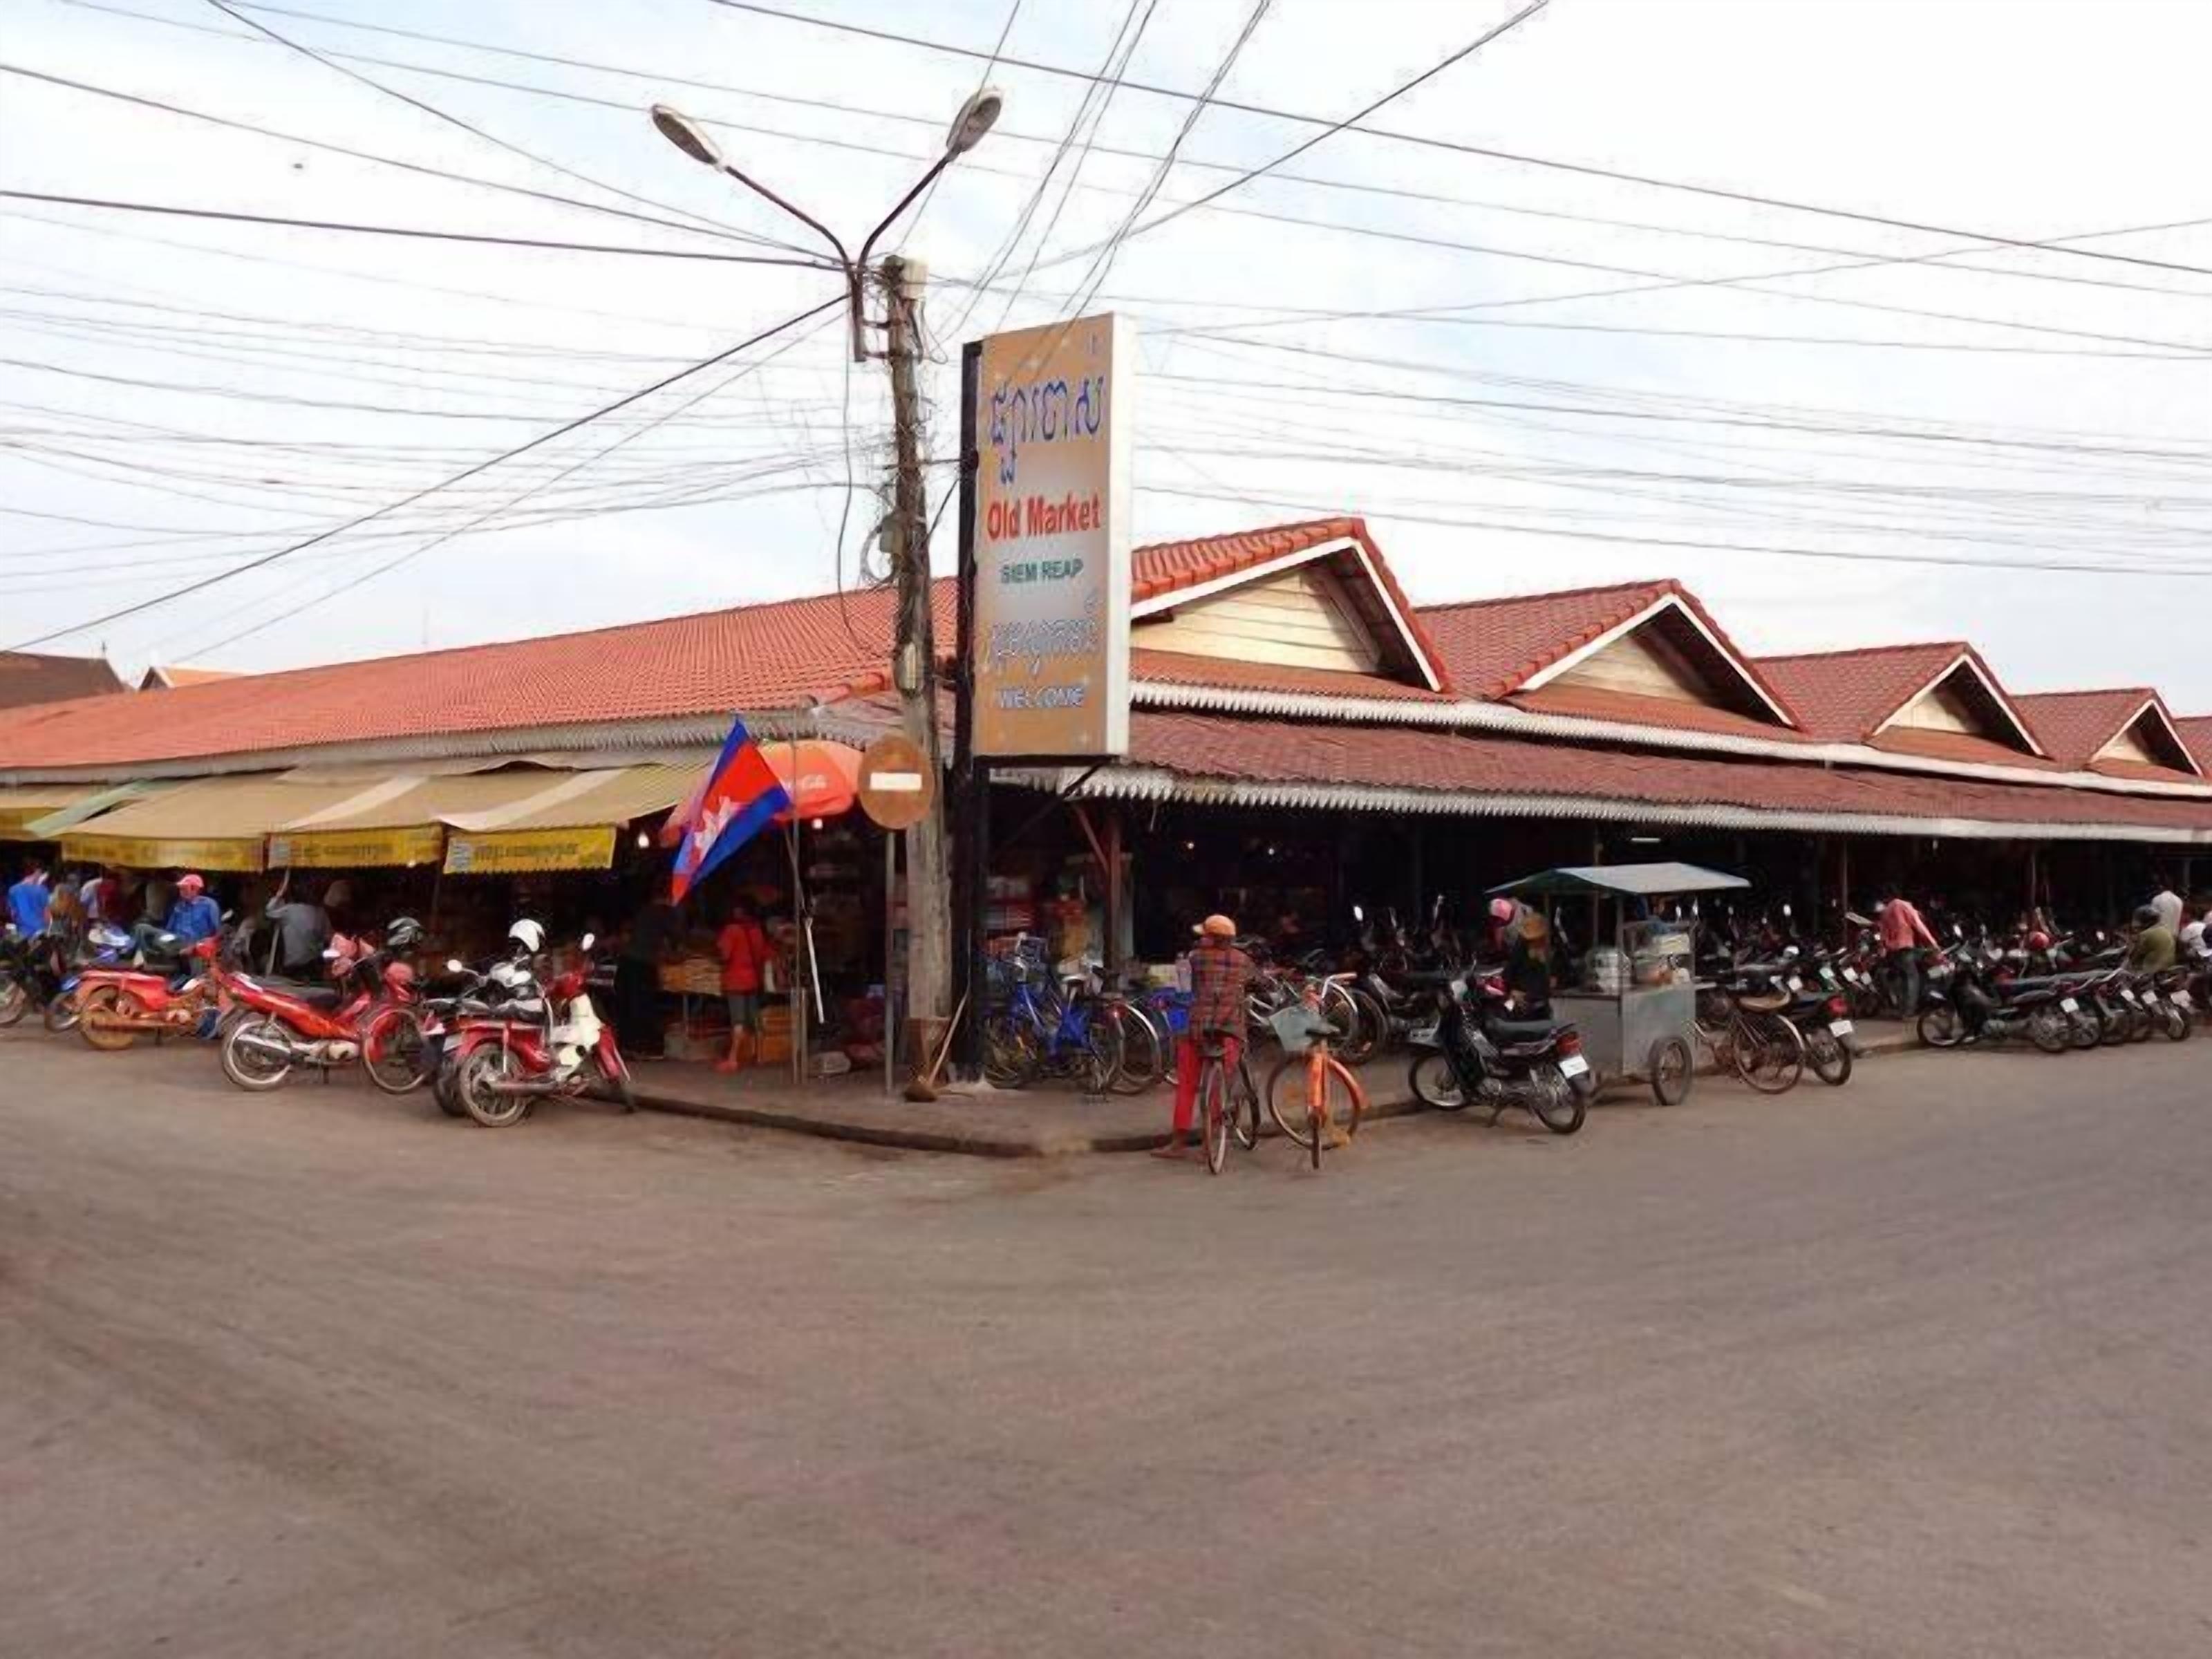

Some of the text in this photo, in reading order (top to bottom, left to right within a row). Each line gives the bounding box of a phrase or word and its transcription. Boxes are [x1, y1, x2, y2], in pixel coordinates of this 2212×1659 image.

[987, 493, 1100, 541] Old Market
[1000, 558, 1084, 584] SIEM REAP
[997, 686, 1085, 709] WELCOME
